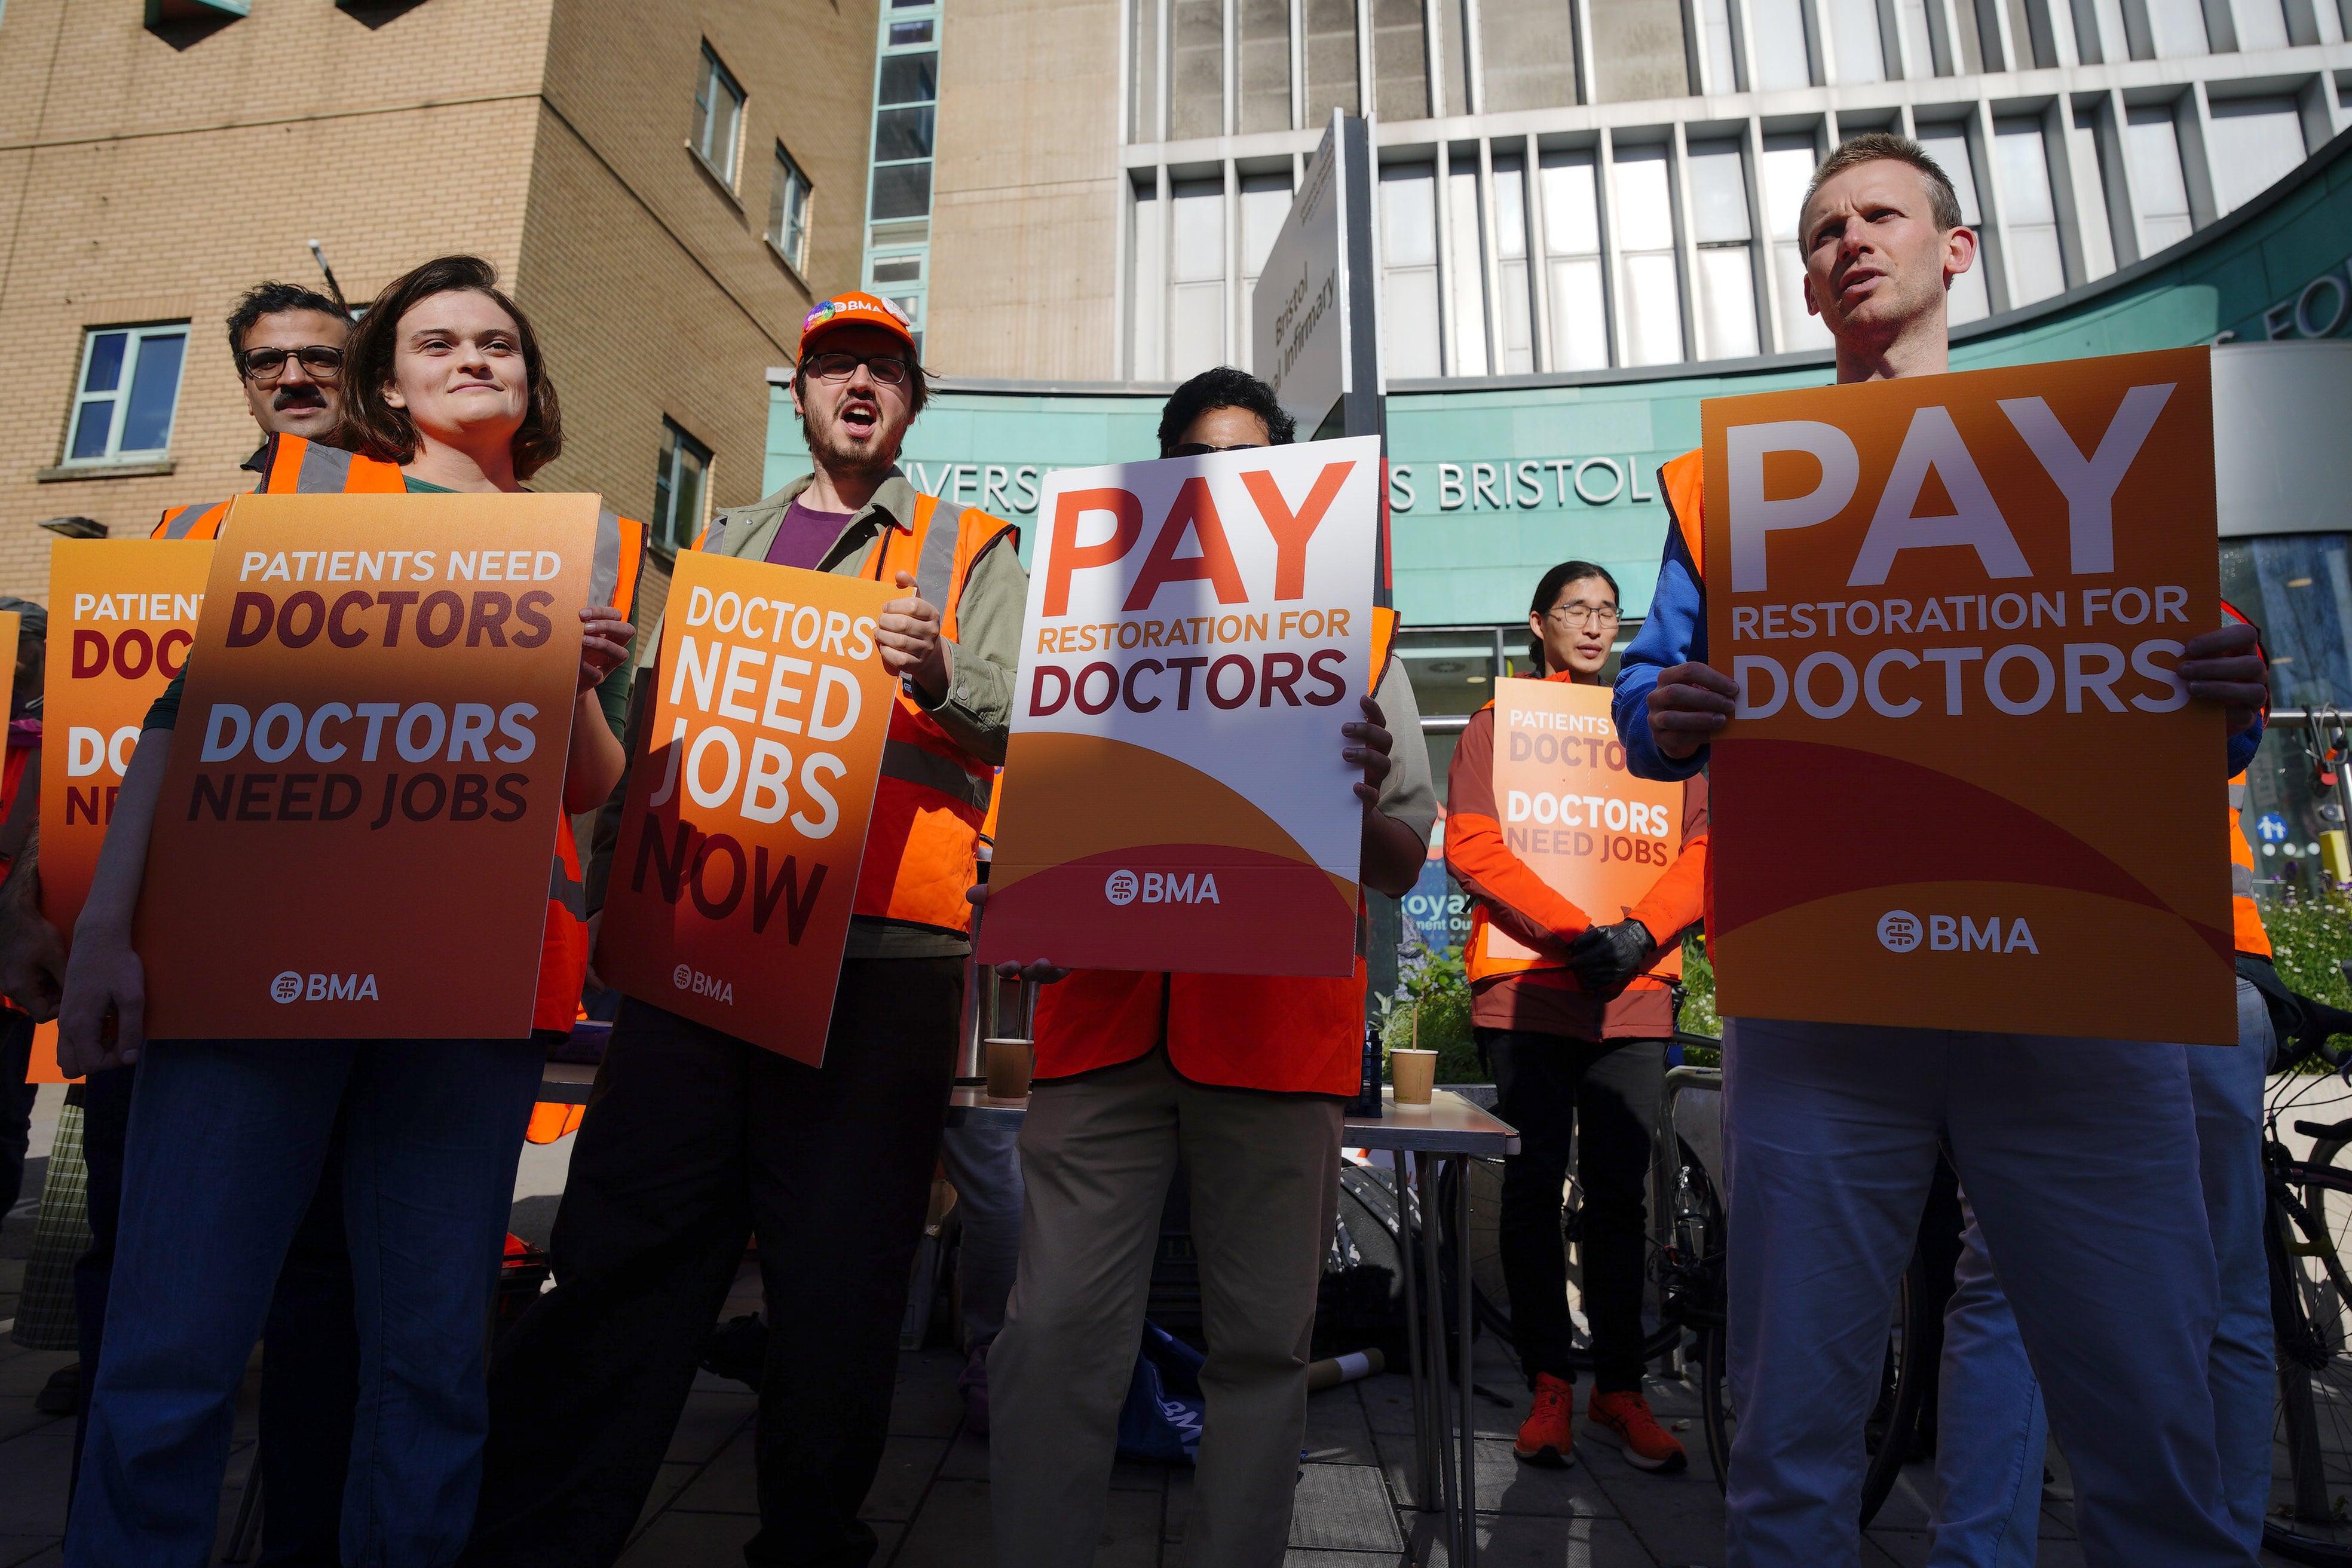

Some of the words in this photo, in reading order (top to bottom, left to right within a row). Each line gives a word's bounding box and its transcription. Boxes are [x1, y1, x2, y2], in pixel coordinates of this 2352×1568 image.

[813, 308, 828, 318] BMA
[848, 300, 884, 314] BMA
[1276, 261, 1307, 348] Bristol
[1285, 268, 1335, 377] Infirmary
[1438, 456, 1653, 510] BRISTOL
[1726, 382, 2178, 593] PAY
[240, 550, 436, 581] PATIENTS
[446, 550, 561, 581] NEED
[1043, 460, 1356, 618] PAY
[74, 593, 204, 620] PATIEN
[226, 590, 555, 648] DOCTORS
[687, 586, 877, 661] DOCTORS
[1038, 614, 1268, 654] RESTORATION
[1279, 608, 1349, 639] FOR
[1732, 592, 2065, 641] RESTORATION
[2084, 584, 2189, 626] FOR
[670, 636, 861, 741] NEED
[1029, 649, 1346, 717] DOCTORS
[1732, 638, 2191, 720] DOCTORS
[200, 702, 539, 763] DOCTORS
[1510, 709, 1609, 735] PATIENTS
[188, 774, 362, 821] NEED
[370, 773, 530, 831] JOBS
[650, 718, 846, 840] JOBS
[1508, 790, 1668, 837] DOCTORS
[1507, 828, 1593, 856] NEED
[1600, 835, 1667, 866] JOBS
[632, 813, 829, 947] NOW
[1142, 873, 1220, 904] BMA
[1401, 894, 1471, 921] oya
[1930, 914, 2039, 955] BMA
[305, 974, 379, 1001] BMA
[692, 970, 733, 1006] BMA
[1156, 1394, 1203, 1464] BM
